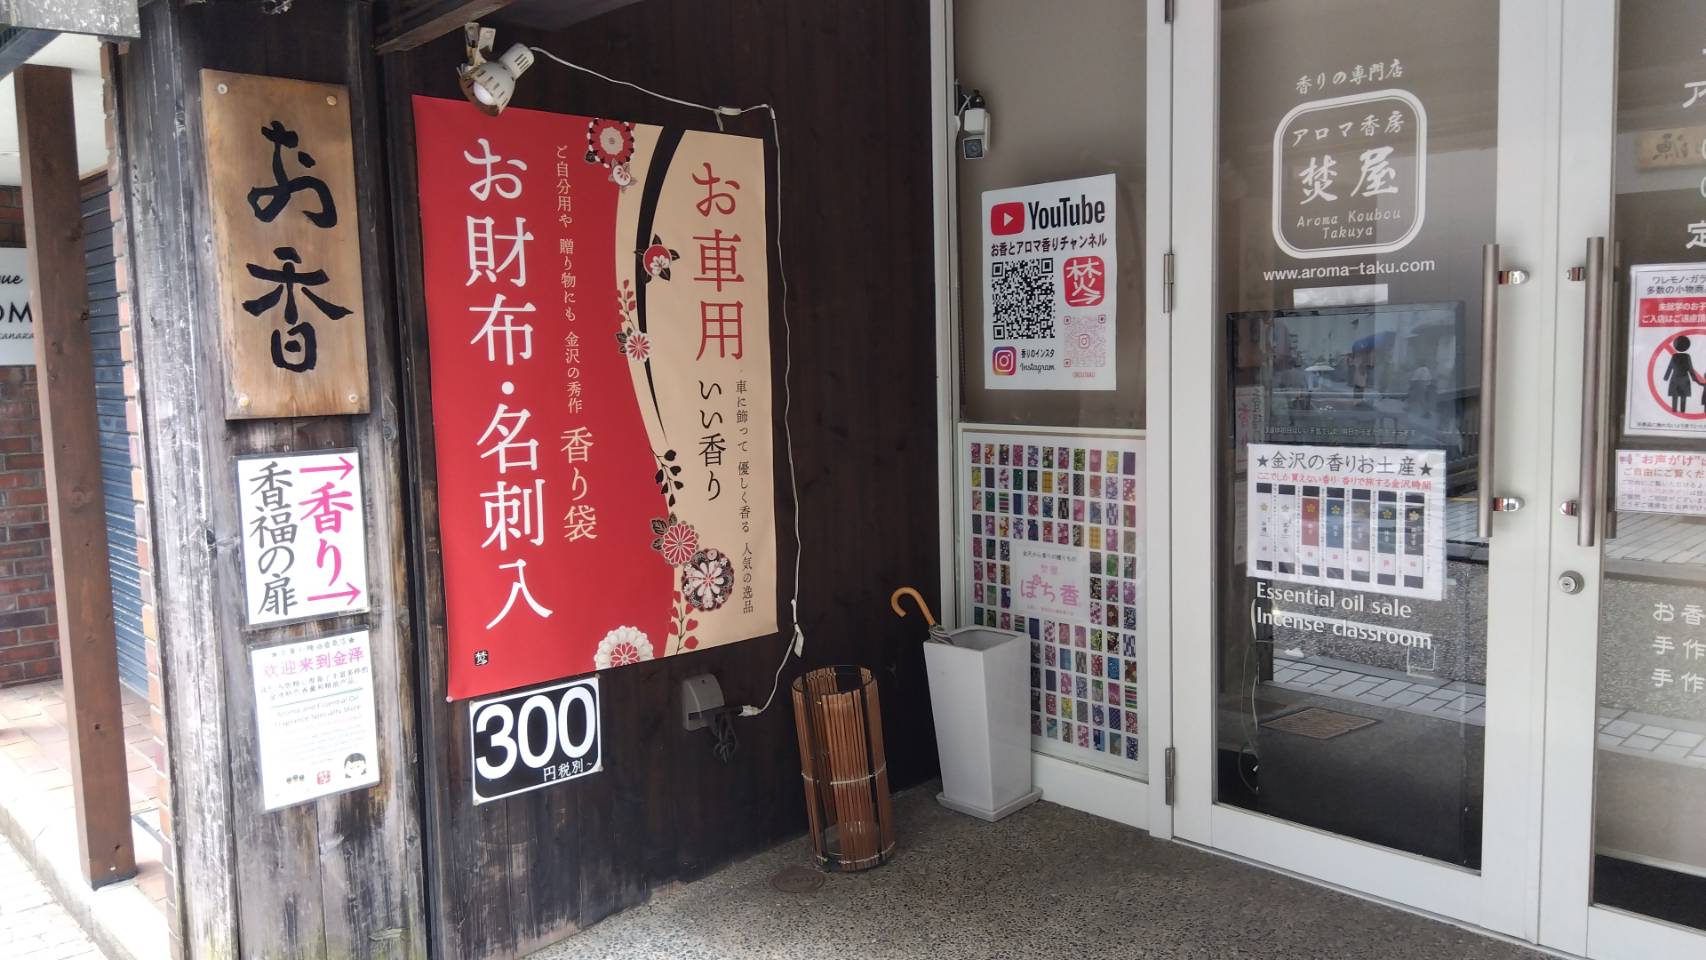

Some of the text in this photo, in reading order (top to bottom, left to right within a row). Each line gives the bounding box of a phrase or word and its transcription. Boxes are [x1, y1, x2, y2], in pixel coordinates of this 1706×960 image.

[1296, 58, 1404, 95] 香りの専門店
[1292, 110, 1405, 147] アロマ香房
[1298, 146, 1400, 205] 焚屋
[1028, 194, 1106, 231] YouTube
[1297, 207, 1402, 228] Aroma Koubou
[243, 120, 354, 372] お香
[991, 233, 1107, 257] お香とアロマ香りチャンネル
[1323, 225, 1374, 240] Takuya
[0, 273, 23, 285] ue
[1263, 258, 1436, 282] www.aroma-taku.com
[1647, 285, 1706, 295] 多数の小物商
[691, 162, 745, 502] お車用 いい香り
[464, 138, 553, 629] お財布・名刺入
[564, 331, 584, 414] 金沢の秀作
[1019, 362, 1056, 374] Instagram
[560, 426, 598, 542] 香り袋
[249, 461, 298, 616] 香福の扉
[298, 481, 354, 587] 香り
[1256, 581, 1412, 618] Essential oil sale
[1256, 606, 1432, 650] Incense classroom
[475, 685, 596, 780] 300
